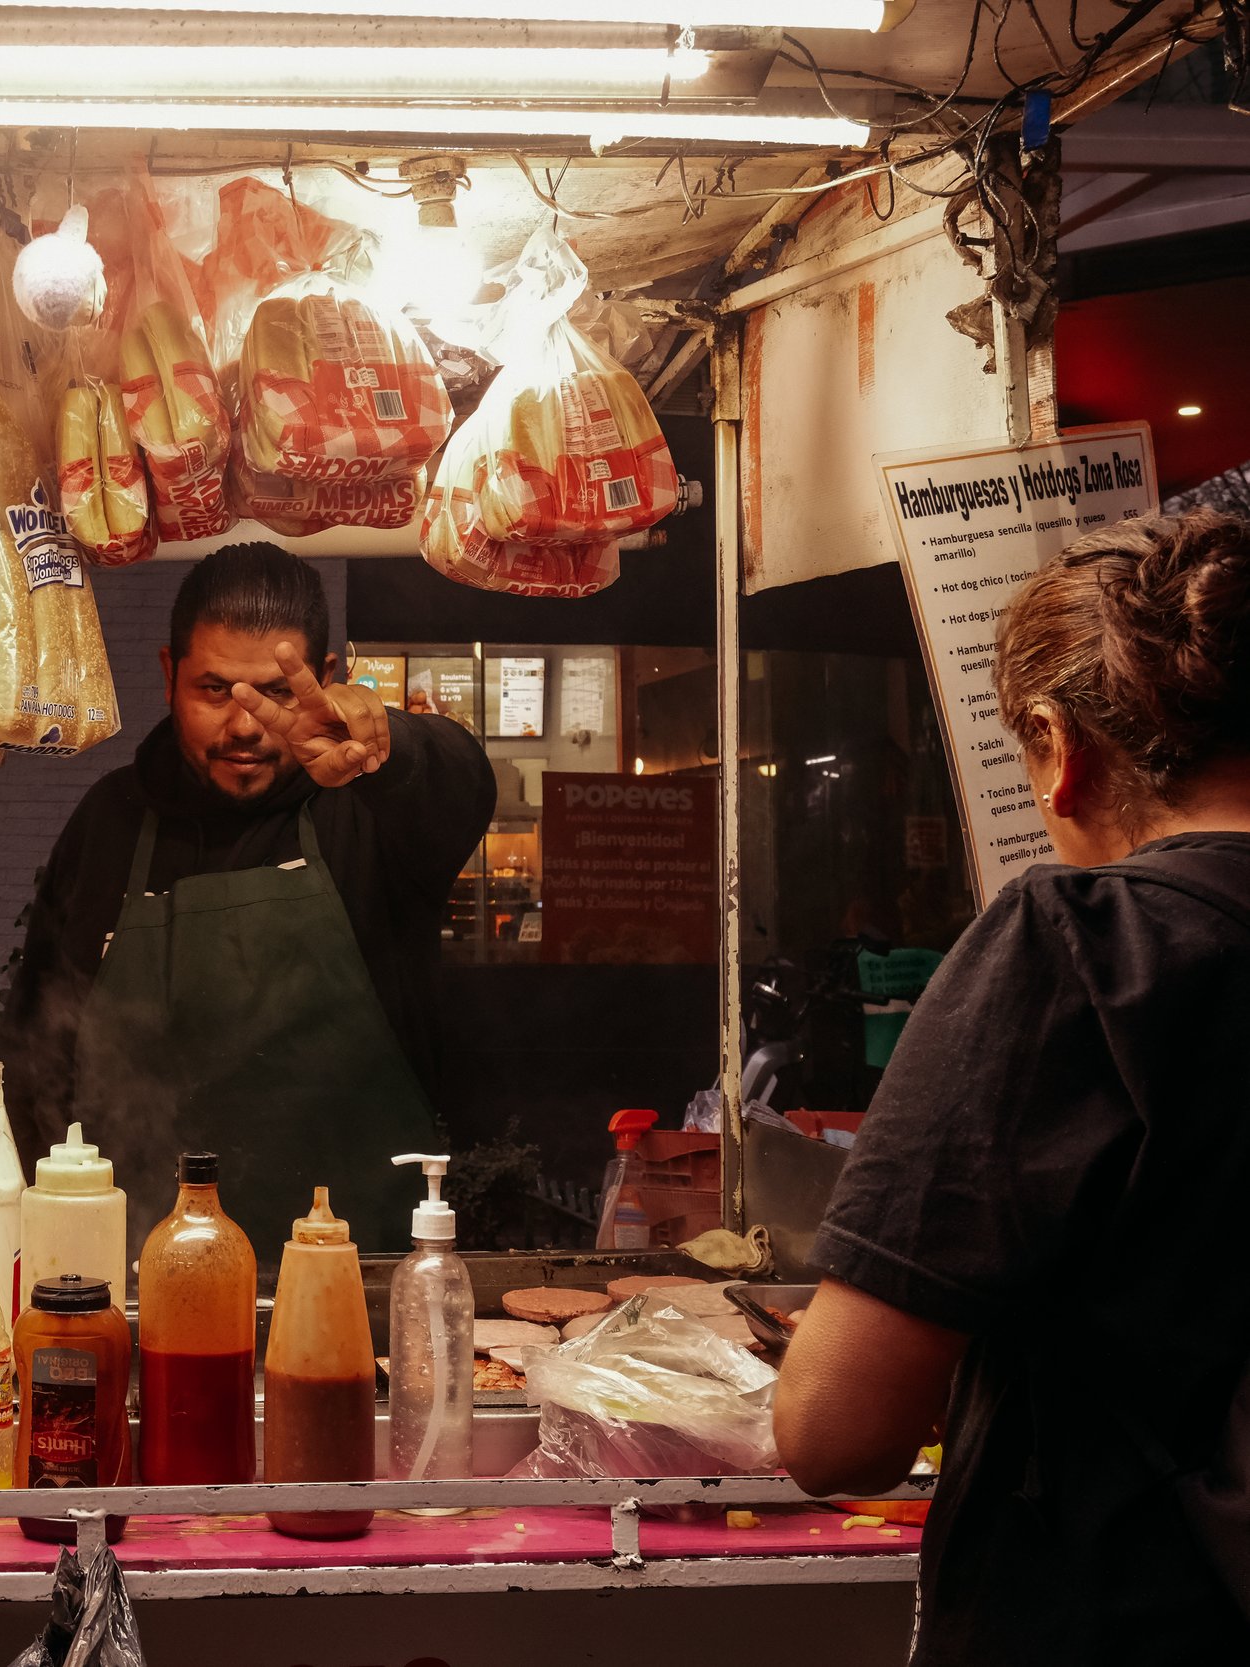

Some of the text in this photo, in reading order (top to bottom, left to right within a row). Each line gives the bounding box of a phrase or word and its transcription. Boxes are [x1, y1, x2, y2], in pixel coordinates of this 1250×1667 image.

[276, 452, 390, 477] NOCHES
[895, 451, 1143, 521] Hamburguesas y Hotdogs Zona Rosa
[315, 481, 414, 510] MEDIAS
[310, 506, 415, 526] NOCHES
[930, 513, 1105, 547] Hamburguesa sencilla (quesillo y queso
[934, 548, 976, 562] amarillo)
[941, 575, 1003, 593] Hot dog chico
[949, 609, 989, 625] Hot dogs
[363, 659, 394, 674] Wings
[968, 691, 996, 705] Jamón
[42, 703, 58, 716] HOT
[58, 705, 75, 718] DOGS
[88, 709, 95, 720] 12
[972, 710, 976, 721] y
[978, 738, 1003, 751] Salchi
[982, 754, 1014, 768] quesillo
[988, 787, 1015, 799] Tocino
[991, 803, 1016, 817] queso
[575, 830, 685, 848] ¡Bienvenidos!
[997, 829, 1049, 847] Hamburgues
[1000, 849, 1037, 864] quesillo y
[543, 856, 711, 873] Estás punto de probar el
[579, 876, 642, 889] Marinado
[645, 879, 667, 891] por
[555, 896, 583, 908] más
[643, 899, 651, 912] y
[37, 1354, 89, 1368] ORIGINAL
